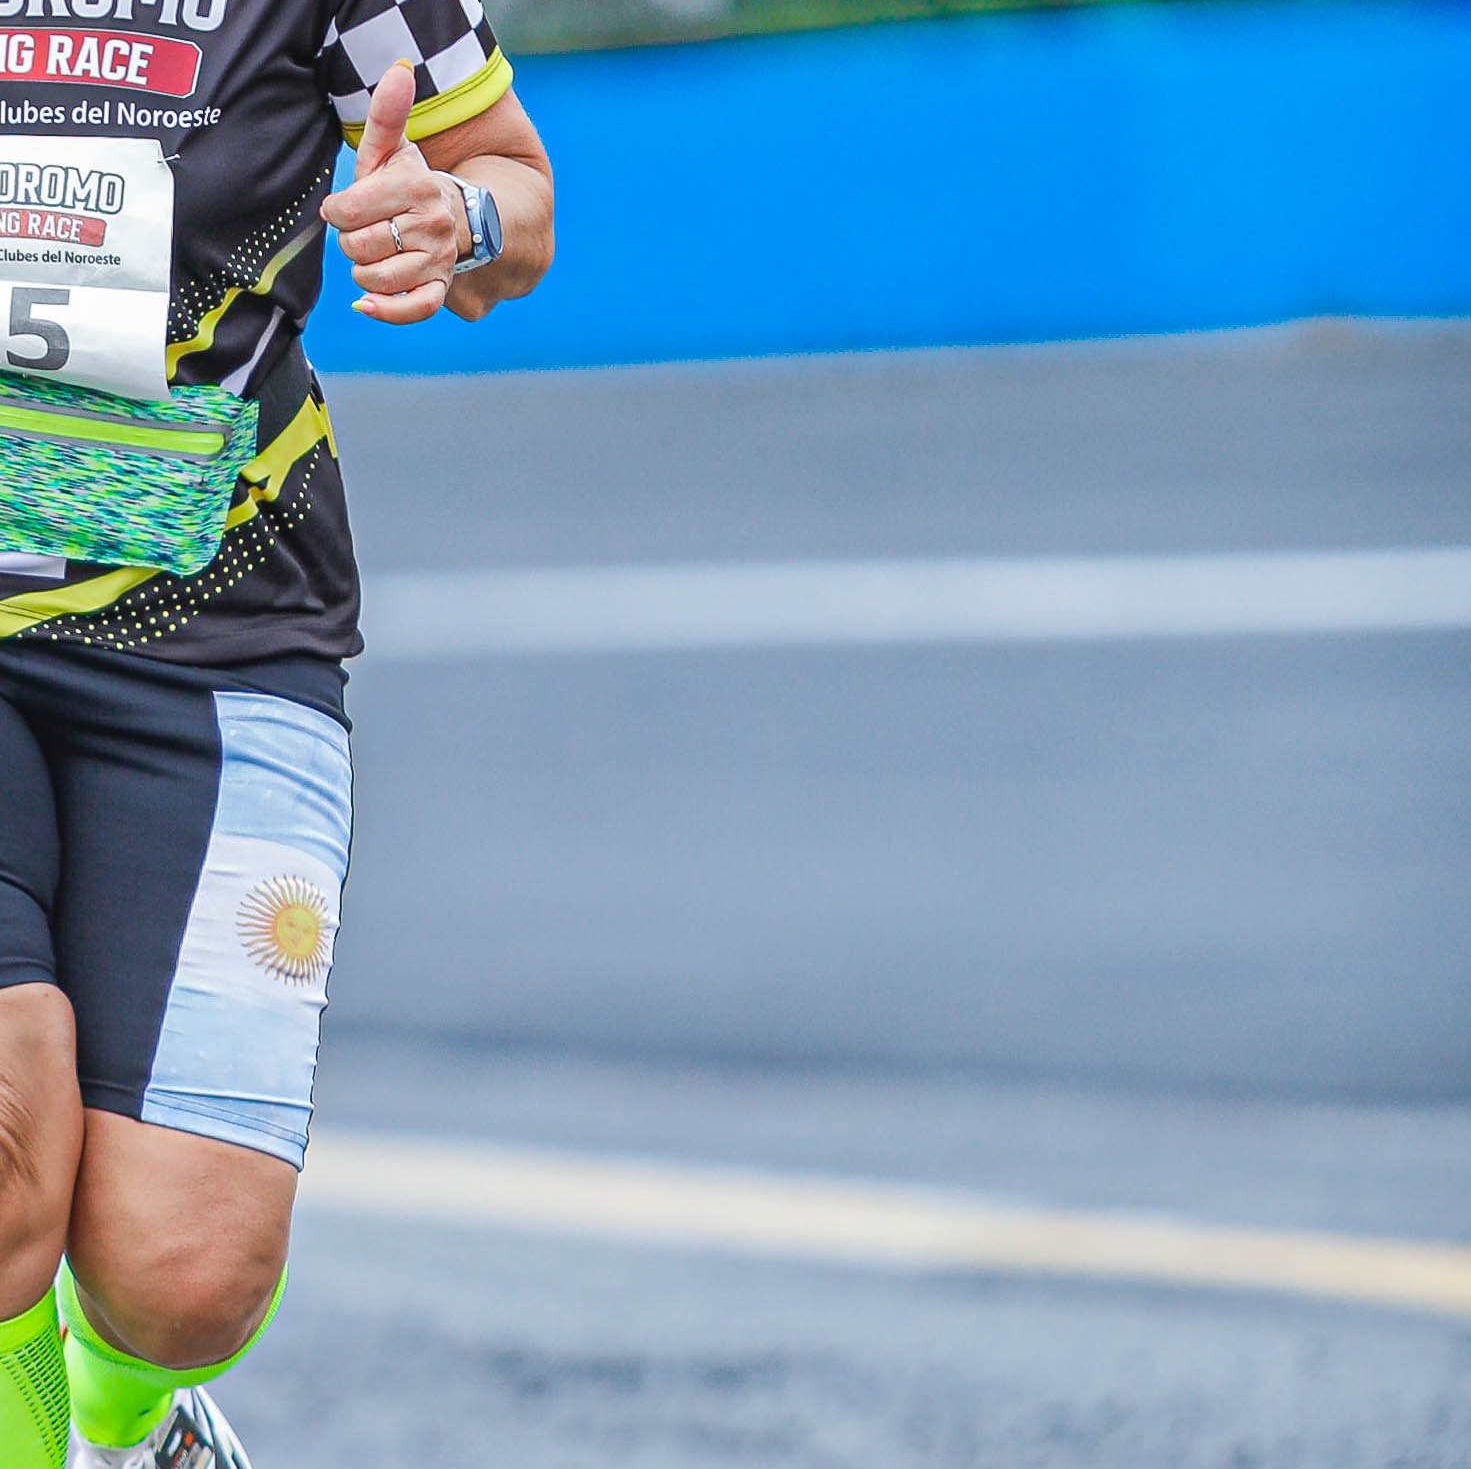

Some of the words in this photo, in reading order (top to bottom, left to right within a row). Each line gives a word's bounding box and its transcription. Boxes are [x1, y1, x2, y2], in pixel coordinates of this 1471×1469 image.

[45, 34, 155, 86] RACE
[71, 100, 110, 124] del
[117, 102, 222, 128] Noroeste
[28, 213, 83, 242] RACE
[42, 249, 62, 263] del
[65, 250, 121, 266] Noroeste
